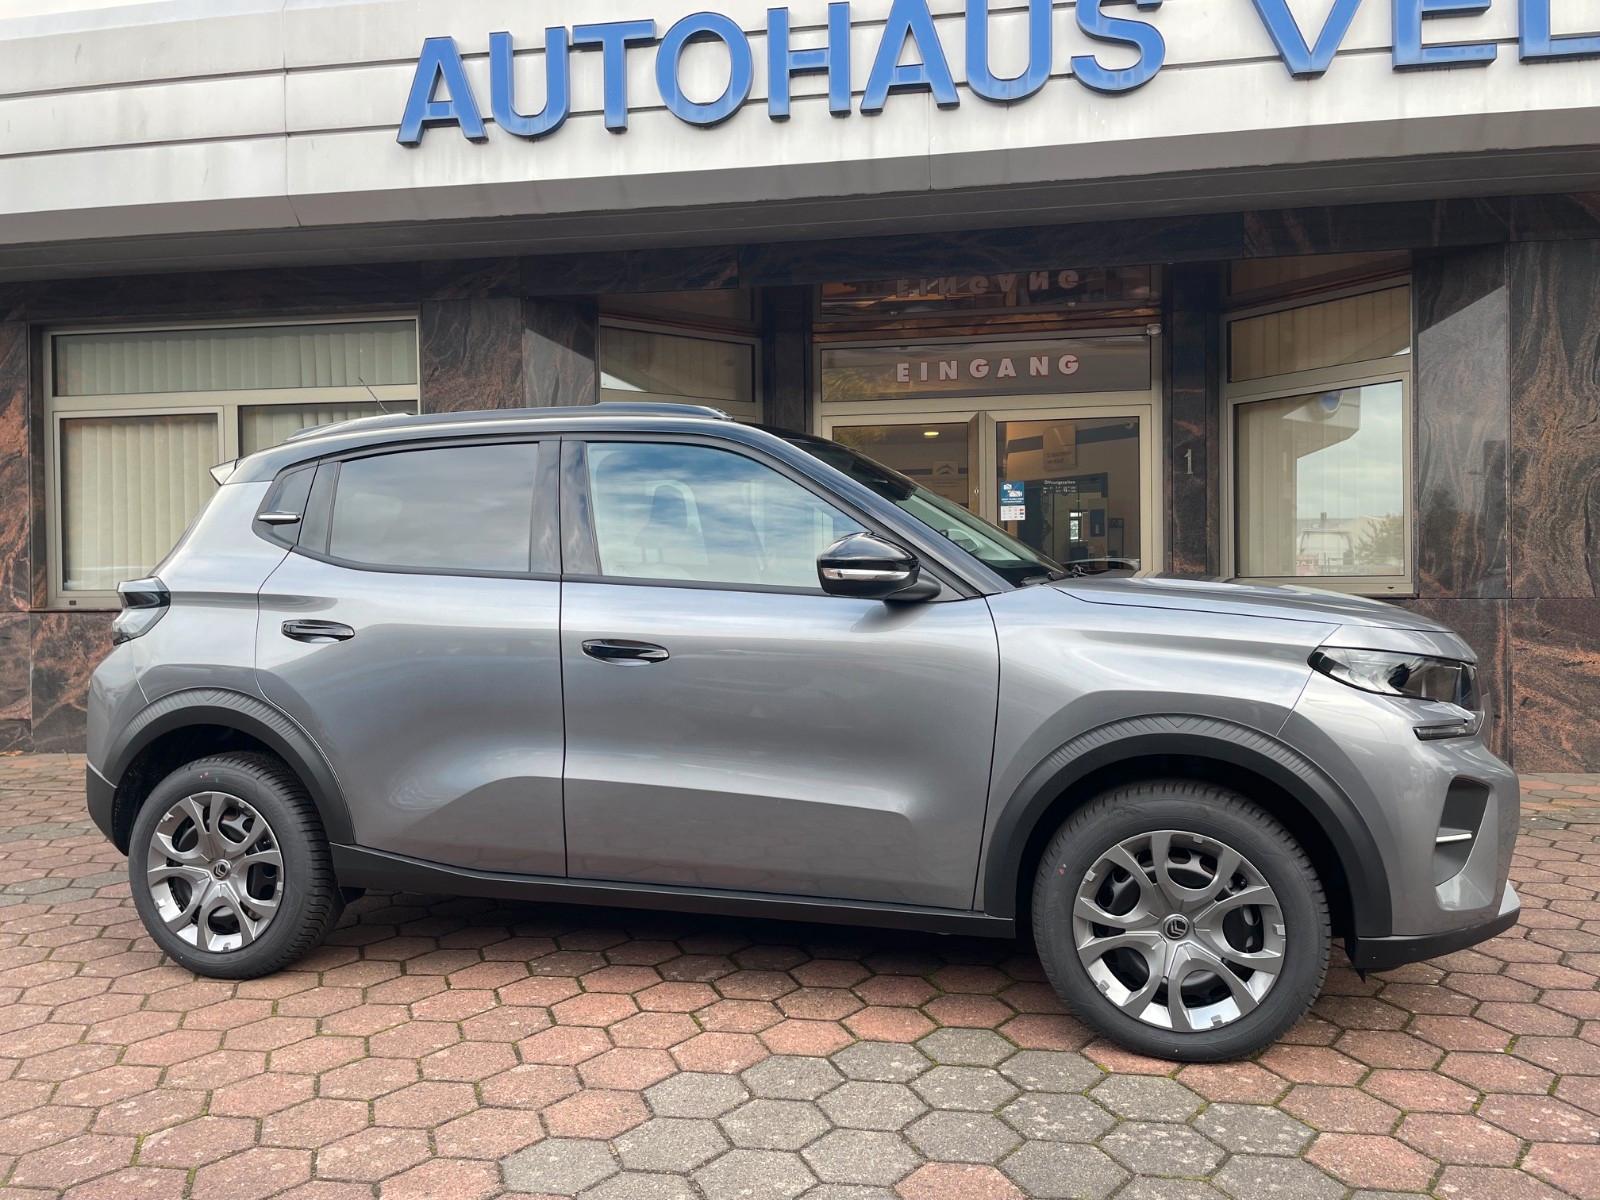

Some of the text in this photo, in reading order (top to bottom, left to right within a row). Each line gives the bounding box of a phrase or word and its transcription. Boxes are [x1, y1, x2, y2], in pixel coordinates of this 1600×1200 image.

[396, 0, 1166, 147] AUTOHAUS
[896, 354, 1080, 383] EINGANG
[1183, 448, 1194, 475] 1
